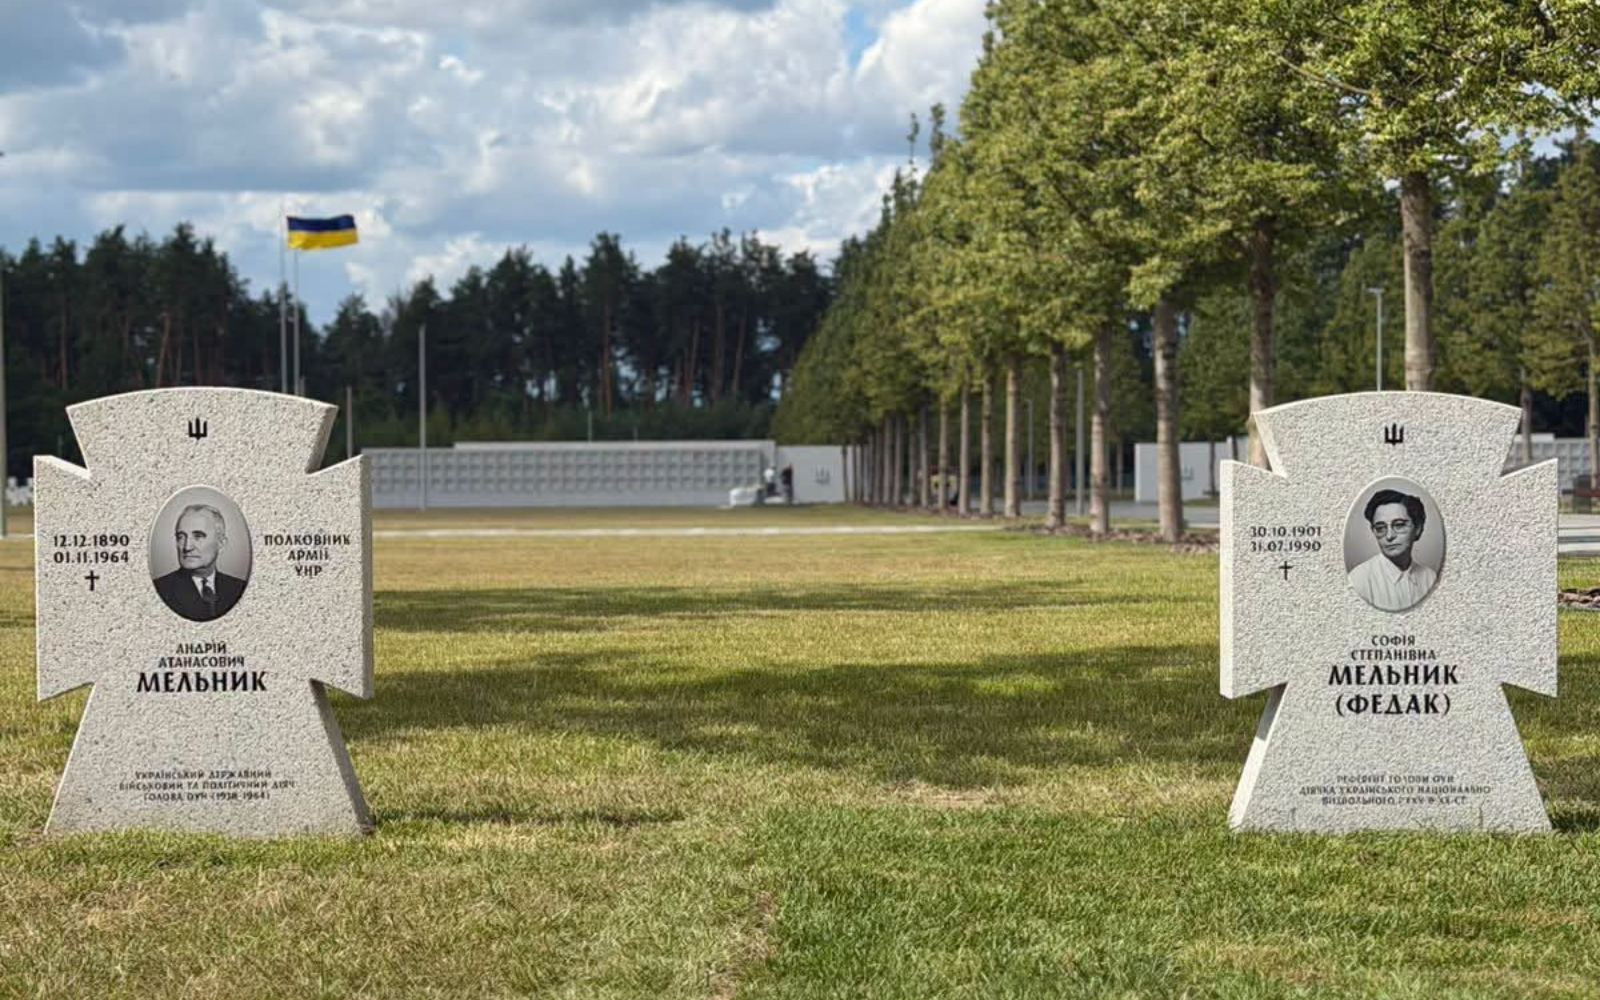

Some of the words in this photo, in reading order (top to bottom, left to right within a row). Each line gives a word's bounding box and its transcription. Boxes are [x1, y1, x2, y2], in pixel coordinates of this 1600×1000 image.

[53, 534, 130, 548] 12.12.1890
[264, 534, 351, 546] ПОЛКОВНИК
[1250, 541, 1322, 552] 31.07.1990
[53, 551, 129, 564] 01.11.1964
[295, 565, 322, 576] УНР
[1372, 634, 1416, 646] СОФІЯ
[176, 642, 226, 654] АНДРІЙ
[1351, 650, 1436, 660] СТЕПАНІВНА
[158, 656, 244, 668] АТАНАСОВИЧ
[1328, 664, 1458, 686] МЕЛЬНИК
[137, 672, 267, 692] МЕЛЬНИК
[1336, 694, 1450, 717] (ФЕДАК)
